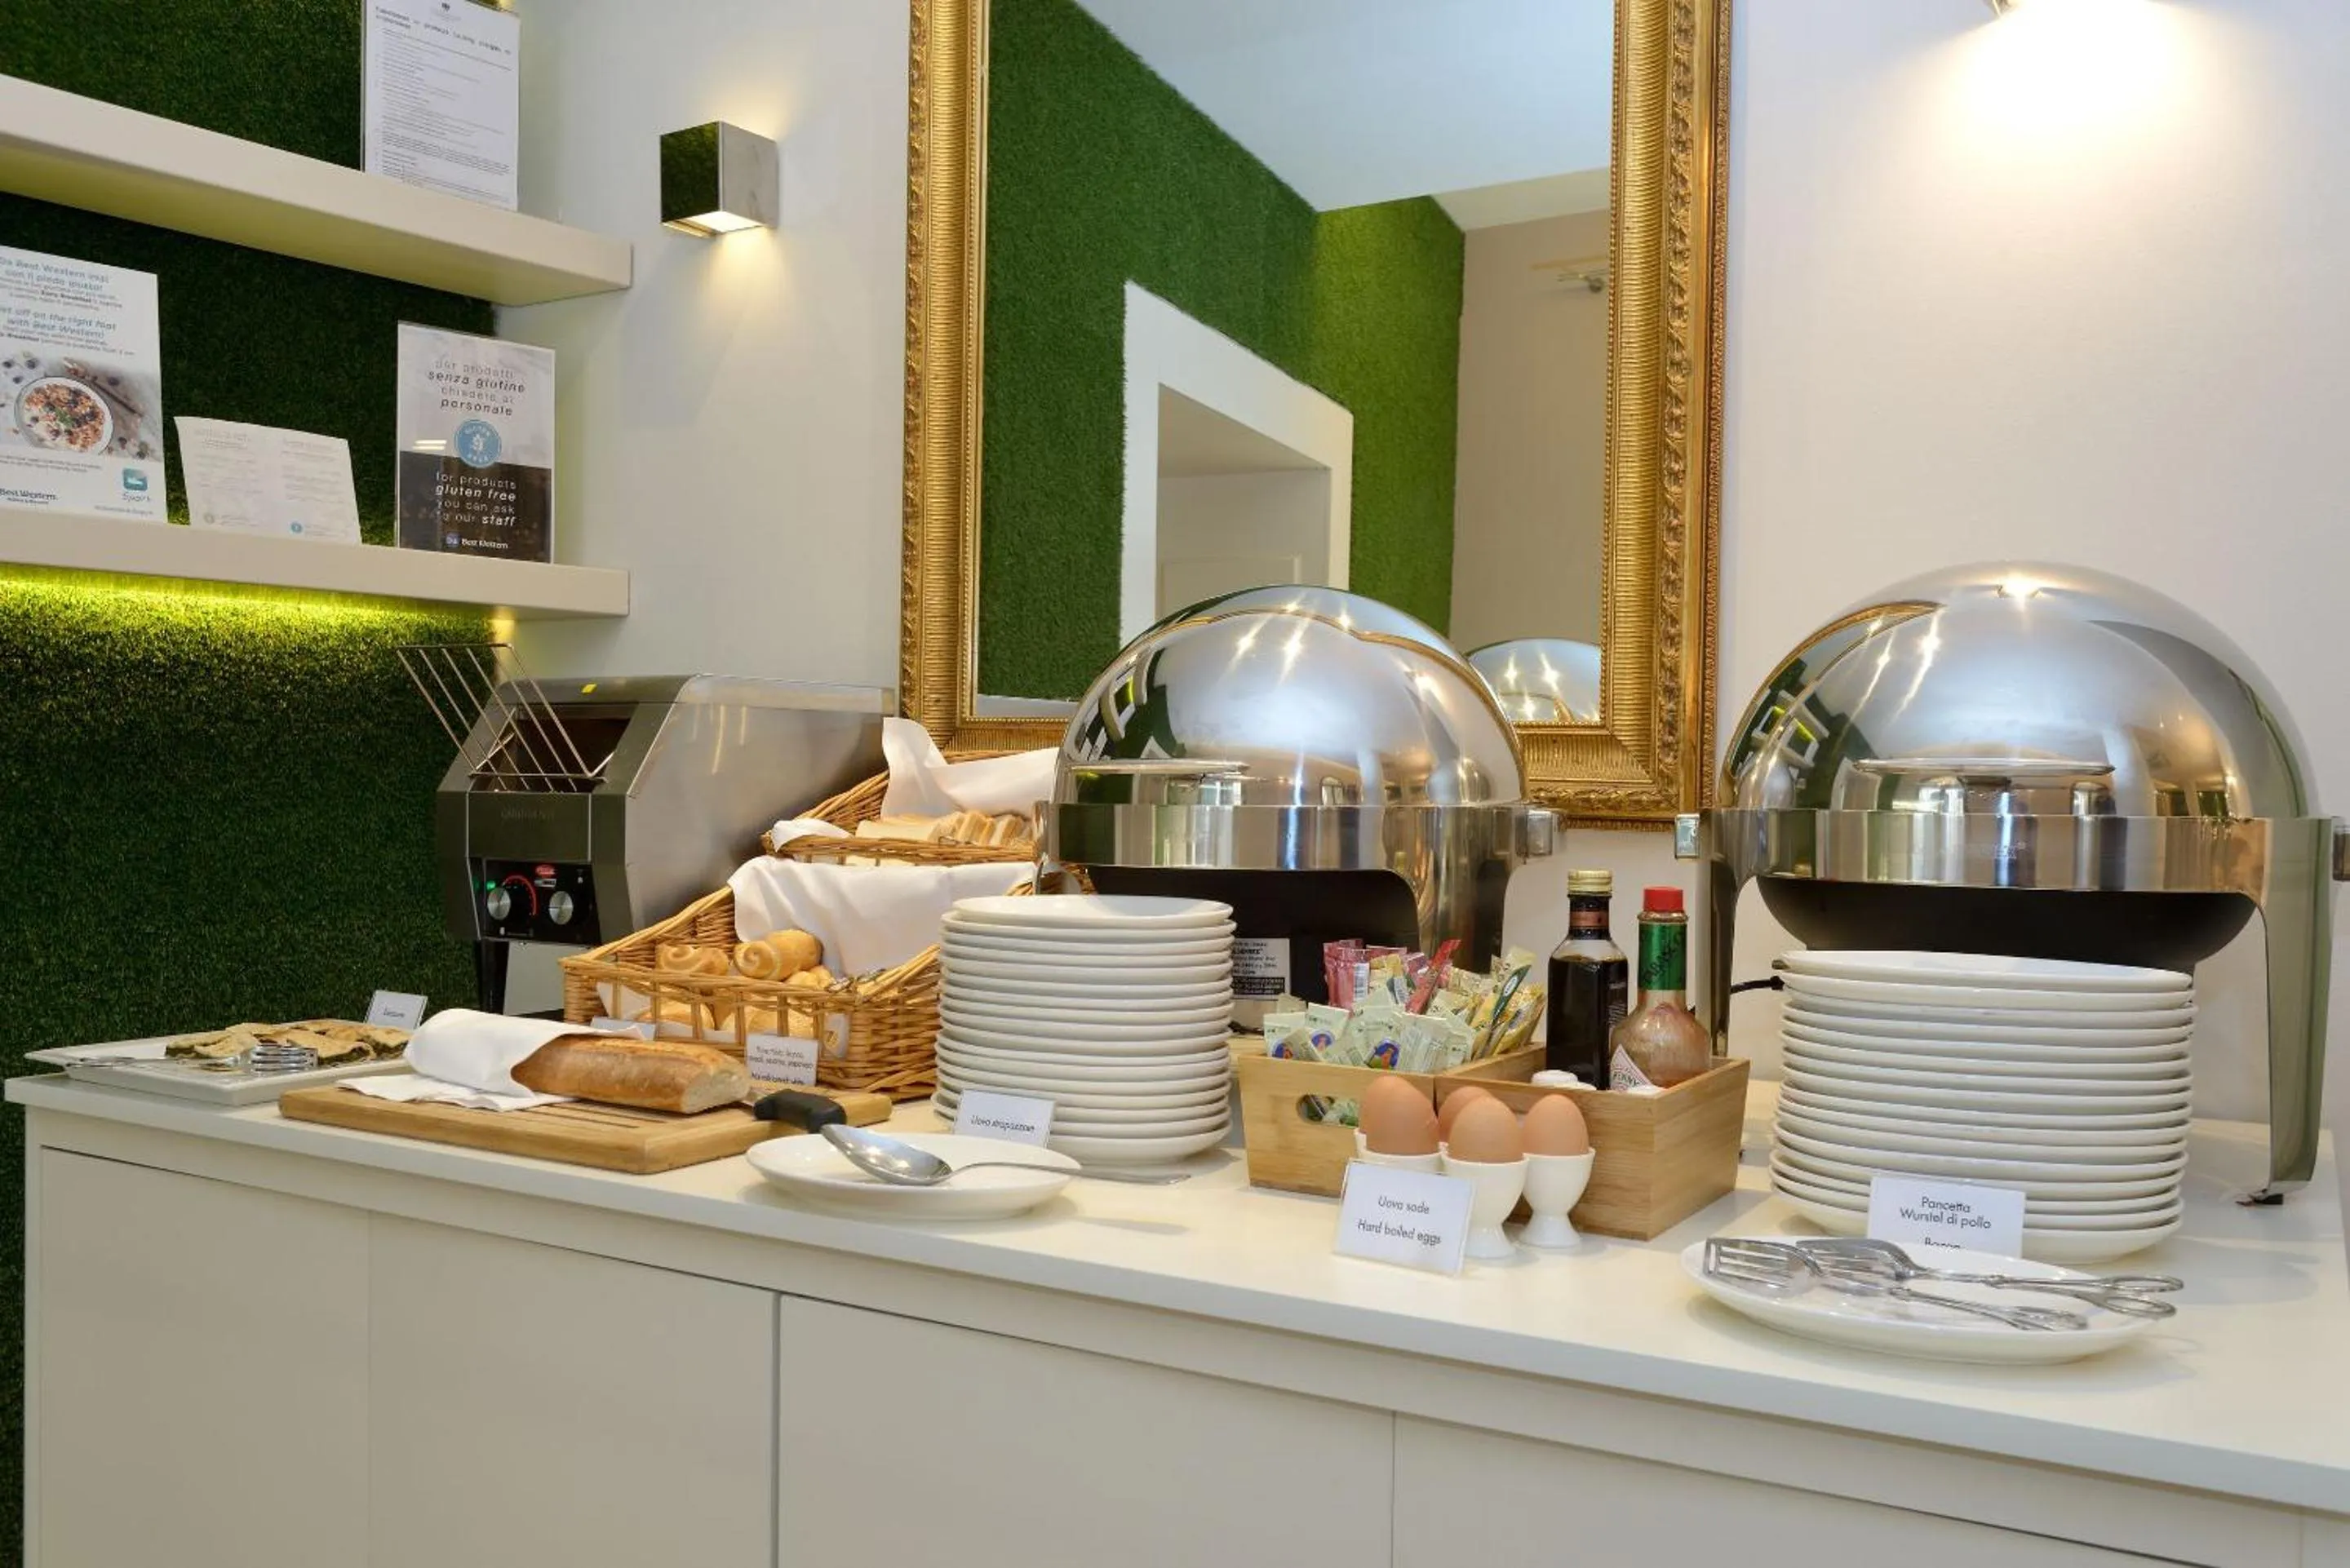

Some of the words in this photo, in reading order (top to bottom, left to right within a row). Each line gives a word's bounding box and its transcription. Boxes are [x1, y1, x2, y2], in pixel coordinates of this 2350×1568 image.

[428, 370, 470, 386] senza
[476, 377, 526, 394] glutine
[441, 398, 513, 417] personale
[437, 470, 454, 483] for
[459, 475, 517, 490] products
[435, 484, 482, 499] gluten
[487, 489, 517, 503] free
[437, 498, 461, 512] you
[466, 502, 489, 512] can
[493, 503, 516, 516] ask
[454, 513, 476, 524] our
[481, 514, 517, 528] staff
[1377, 1195, 1403, 1211] Uova
[1406, 1202, 1430, 1215] sode
[1921, 1195, 1971, 1213] Pancetta
[1900, 1207, 1944, 1224] Wurstel
[1947, 1212, 1958, 1225] di
[1960, 1214, 1992, 1229] pollo
[1357, 1218, 1383, 1234] Hard
[1384, 1221, 1416, 1240] boiled
[1417, 1232, 1443, 1247] eggs
